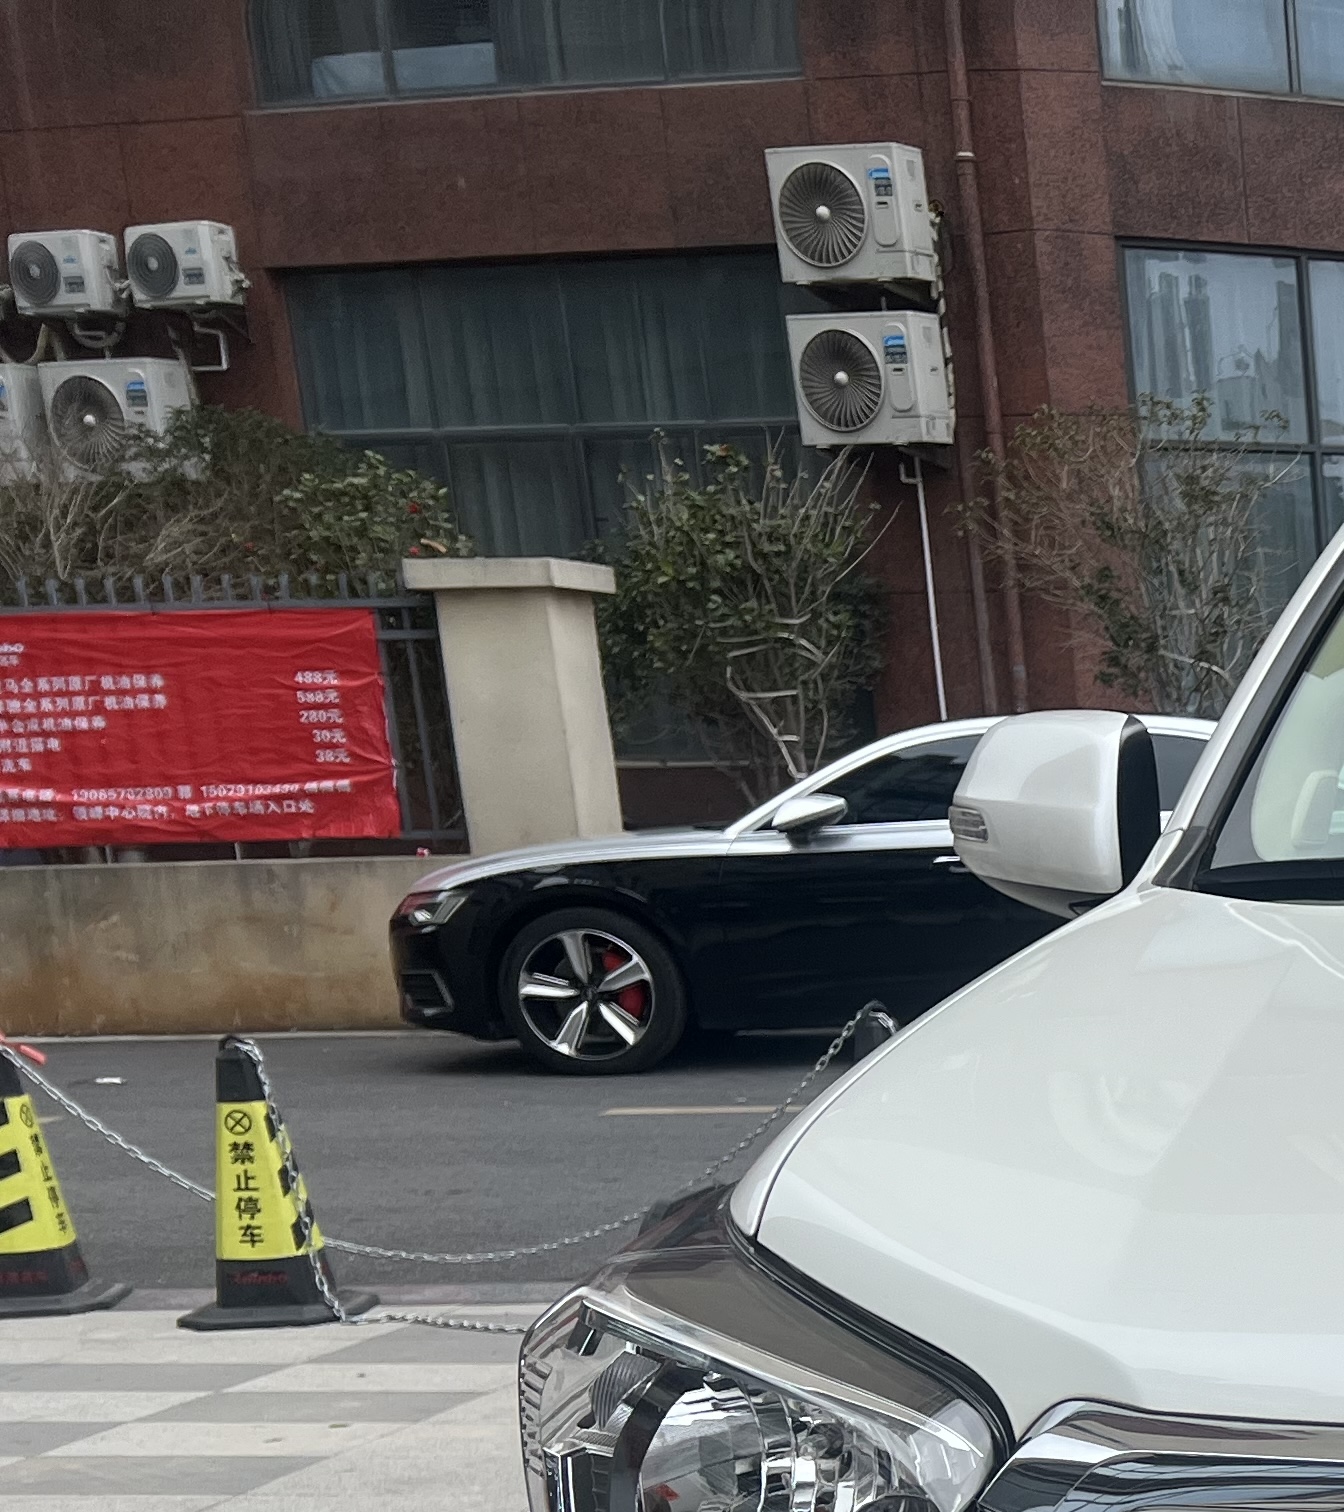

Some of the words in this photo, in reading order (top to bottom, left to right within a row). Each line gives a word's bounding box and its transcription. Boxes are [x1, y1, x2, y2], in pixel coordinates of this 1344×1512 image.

[294, 670, 339, 685] 488元
[298, 708, 344, 723] 280元
[312, 729, 347, 743] 30元
[228, 1140, 264, 1248] 禁止停车
